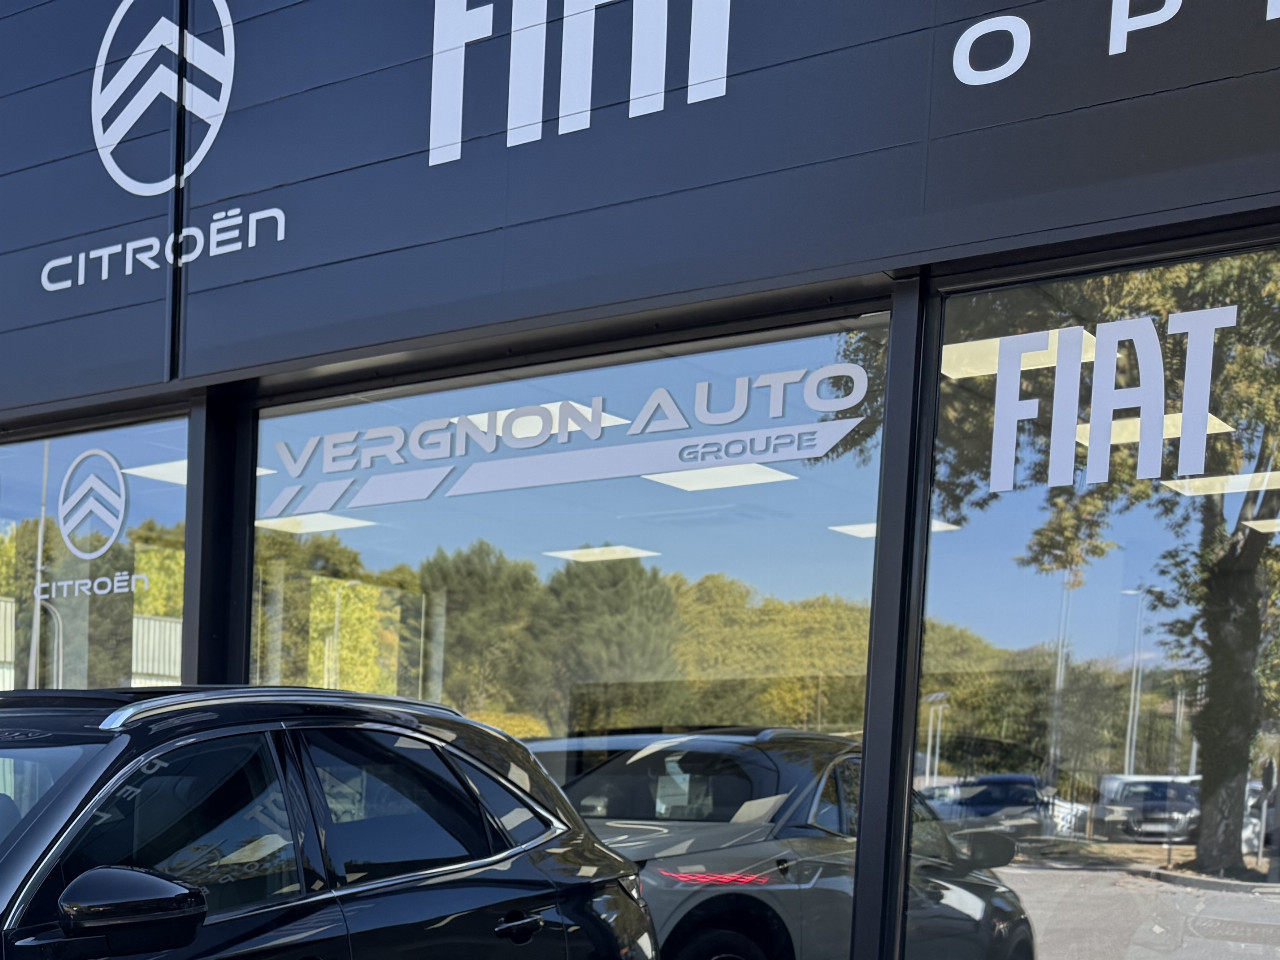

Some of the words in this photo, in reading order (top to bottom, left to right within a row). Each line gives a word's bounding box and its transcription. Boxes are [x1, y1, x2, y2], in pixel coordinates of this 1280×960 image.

[952, 0, 1280, 86] OP
[274, 396, 604, 479] VERGNON
[626, 362, 869, 436] AUTO
[678, 430, 819, 463] GROUPE
[989, 304, 1238, 493] FIAT
